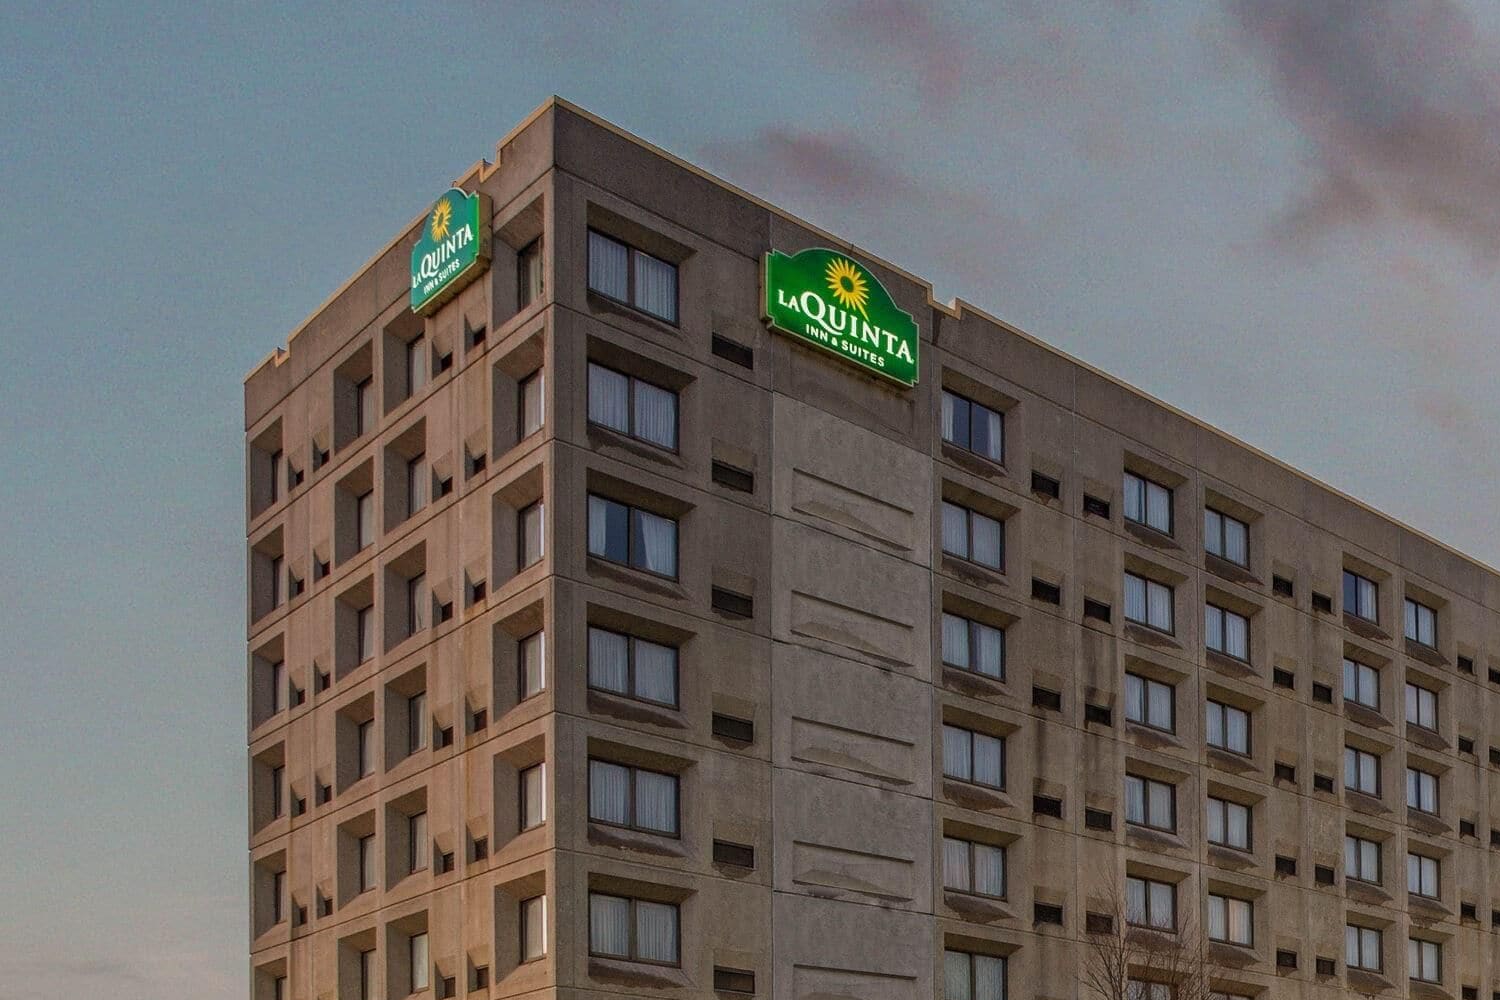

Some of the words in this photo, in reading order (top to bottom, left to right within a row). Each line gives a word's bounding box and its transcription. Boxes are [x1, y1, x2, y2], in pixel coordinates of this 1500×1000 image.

[412, 275, 422, 288] LA
[420, 223, 474, 279] QUINTA
[423, 281, 435, 295] INN
[438, 258, 461, 282] SUITES
[778, 289, 801, 313] LA
[800, 291, 915, 365] QUINTA
[805, 323, 829, 343] INN
[831, 336, 838, 347] &
[841, 339, 885, 368] SUITES
